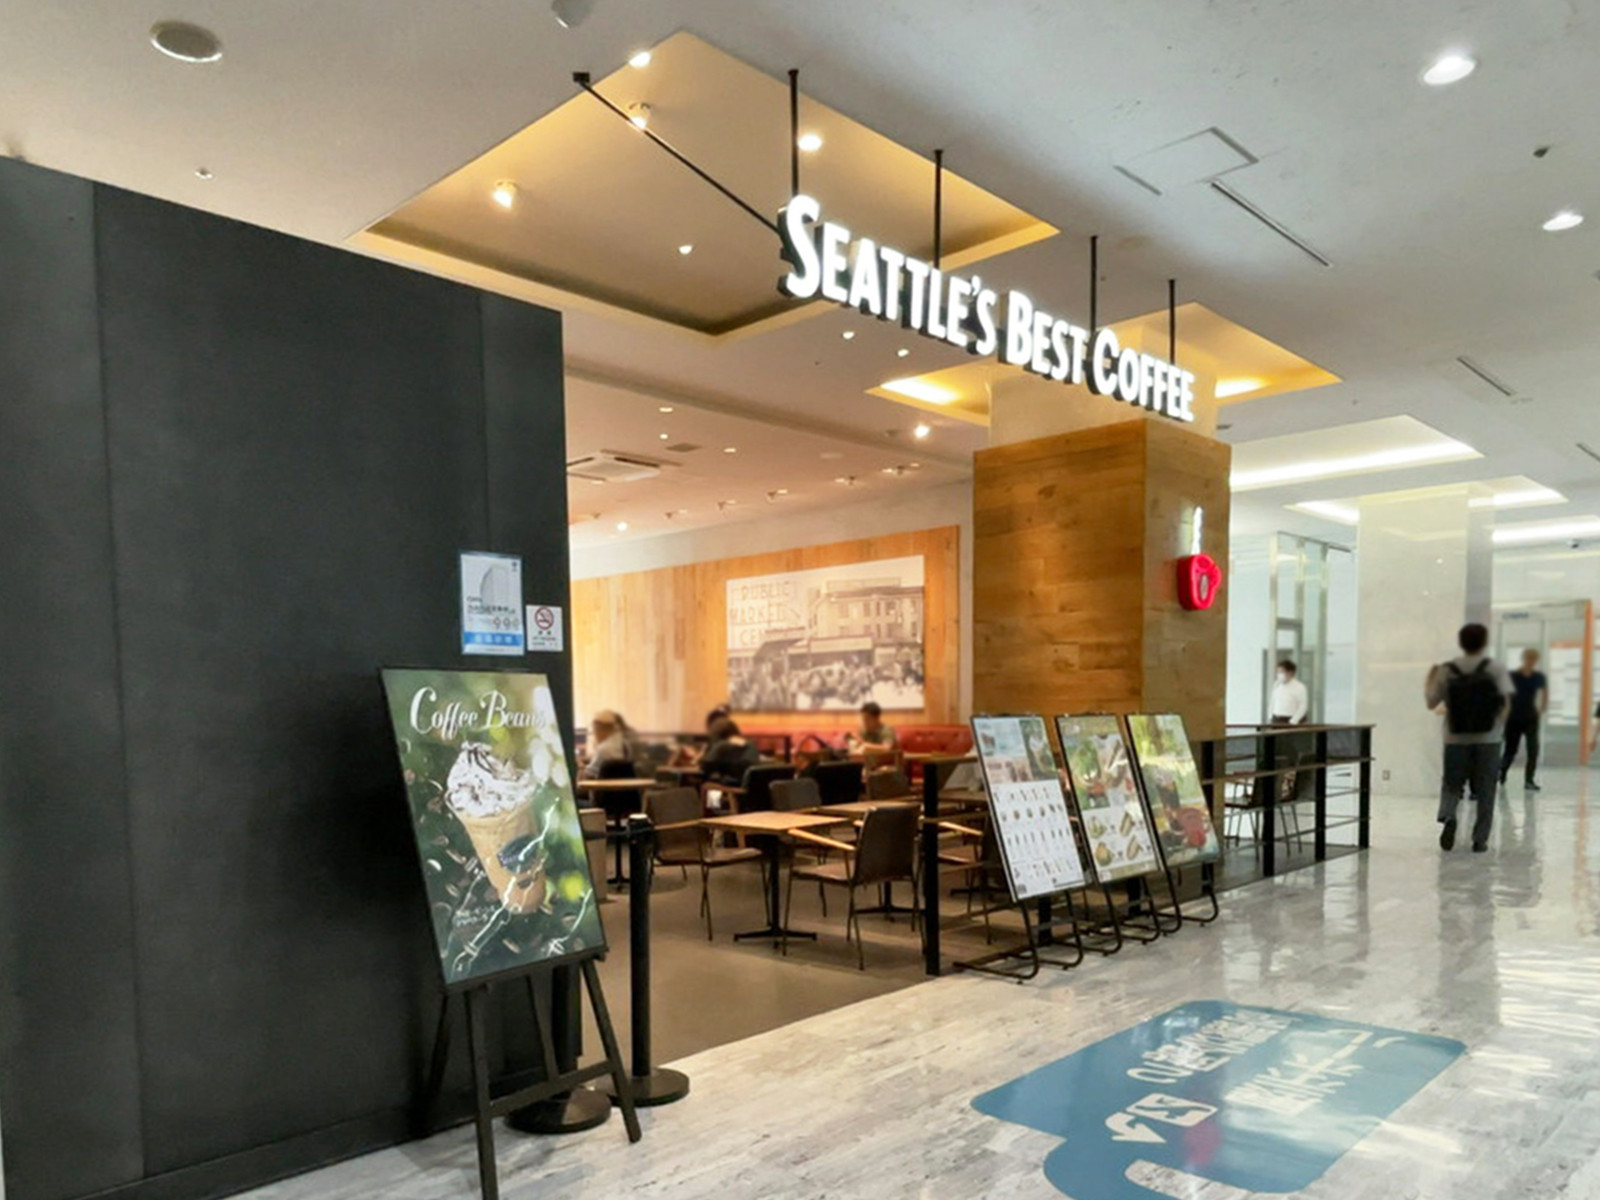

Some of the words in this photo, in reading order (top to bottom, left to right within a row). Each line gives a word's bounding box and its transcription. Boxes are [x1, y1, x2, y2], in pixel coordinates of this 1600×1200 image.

[1005, 289, 1089, 385] BEST
[1092, 326, 1196, 422] COFFEE
[410, 686, 479, 740] Coffee
